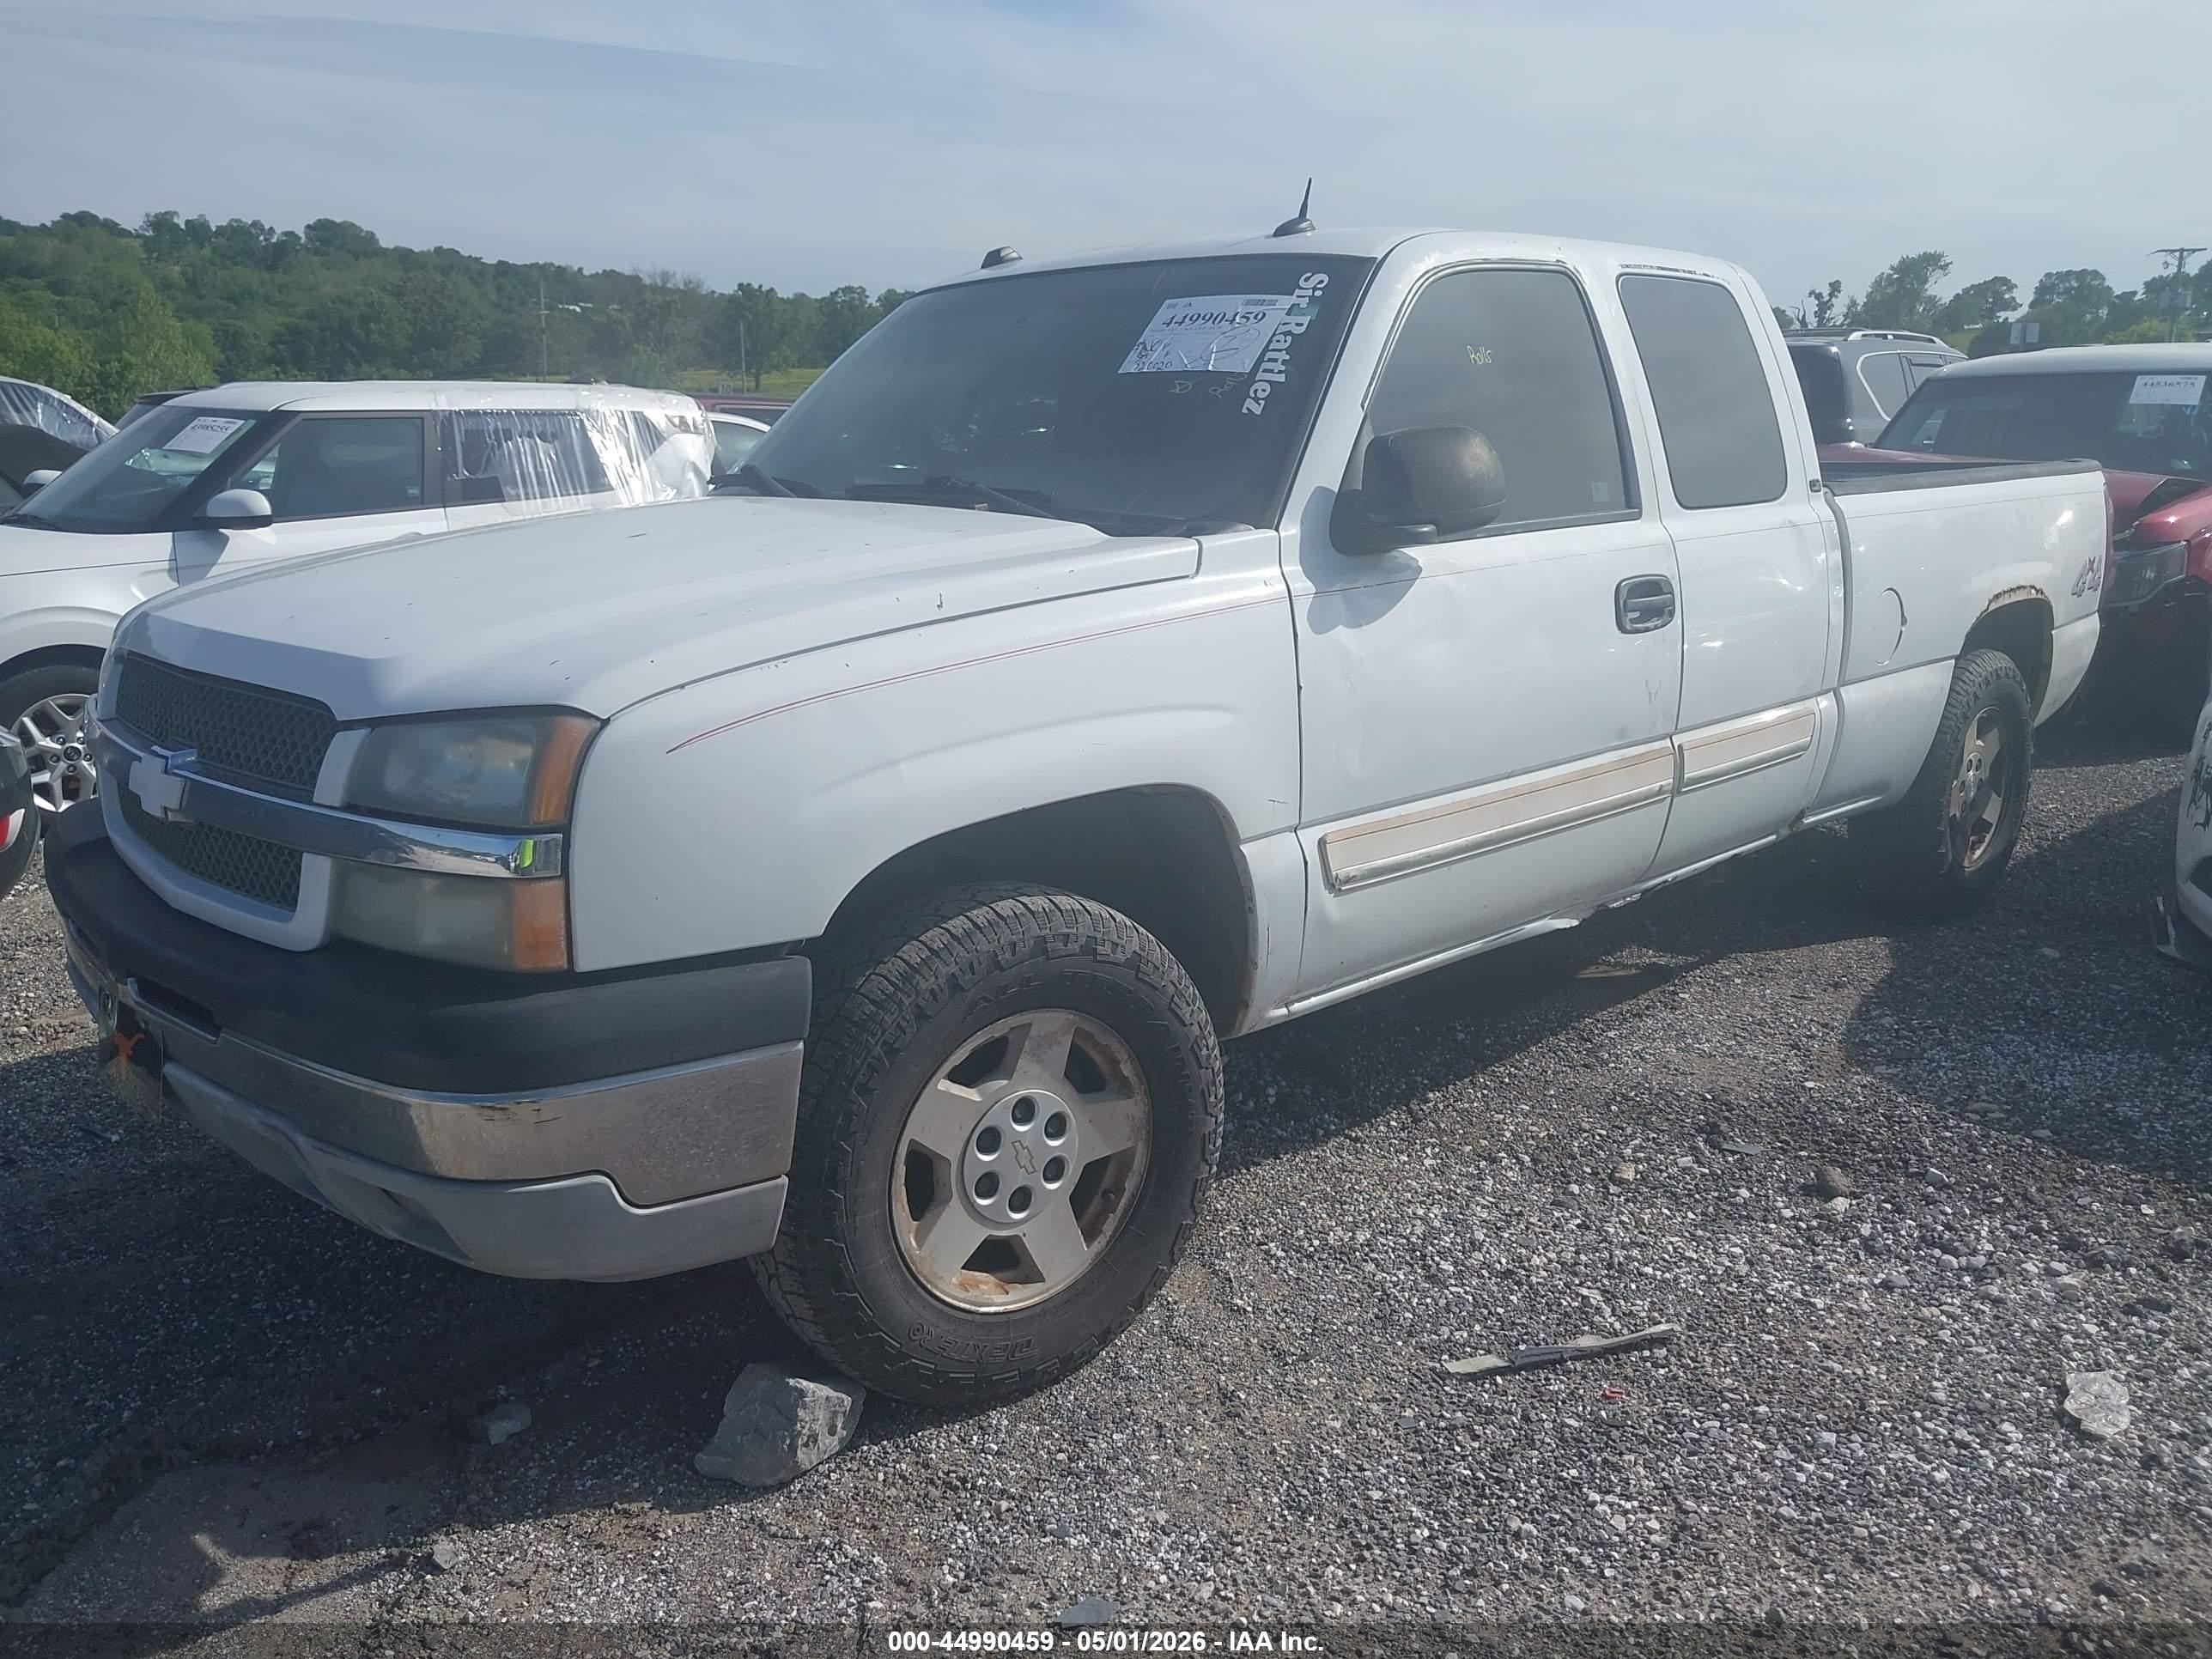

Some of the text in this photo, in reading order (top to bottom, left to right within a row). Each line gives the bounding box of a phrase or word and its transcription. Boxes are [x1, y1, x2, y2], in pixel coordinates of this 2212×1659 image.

[1162, 311, 1267, 328] 44990459
[1241, 271, 1329, 416] Sir Rattlez
[907, 1320, 1038, 1364] DEXTERO
